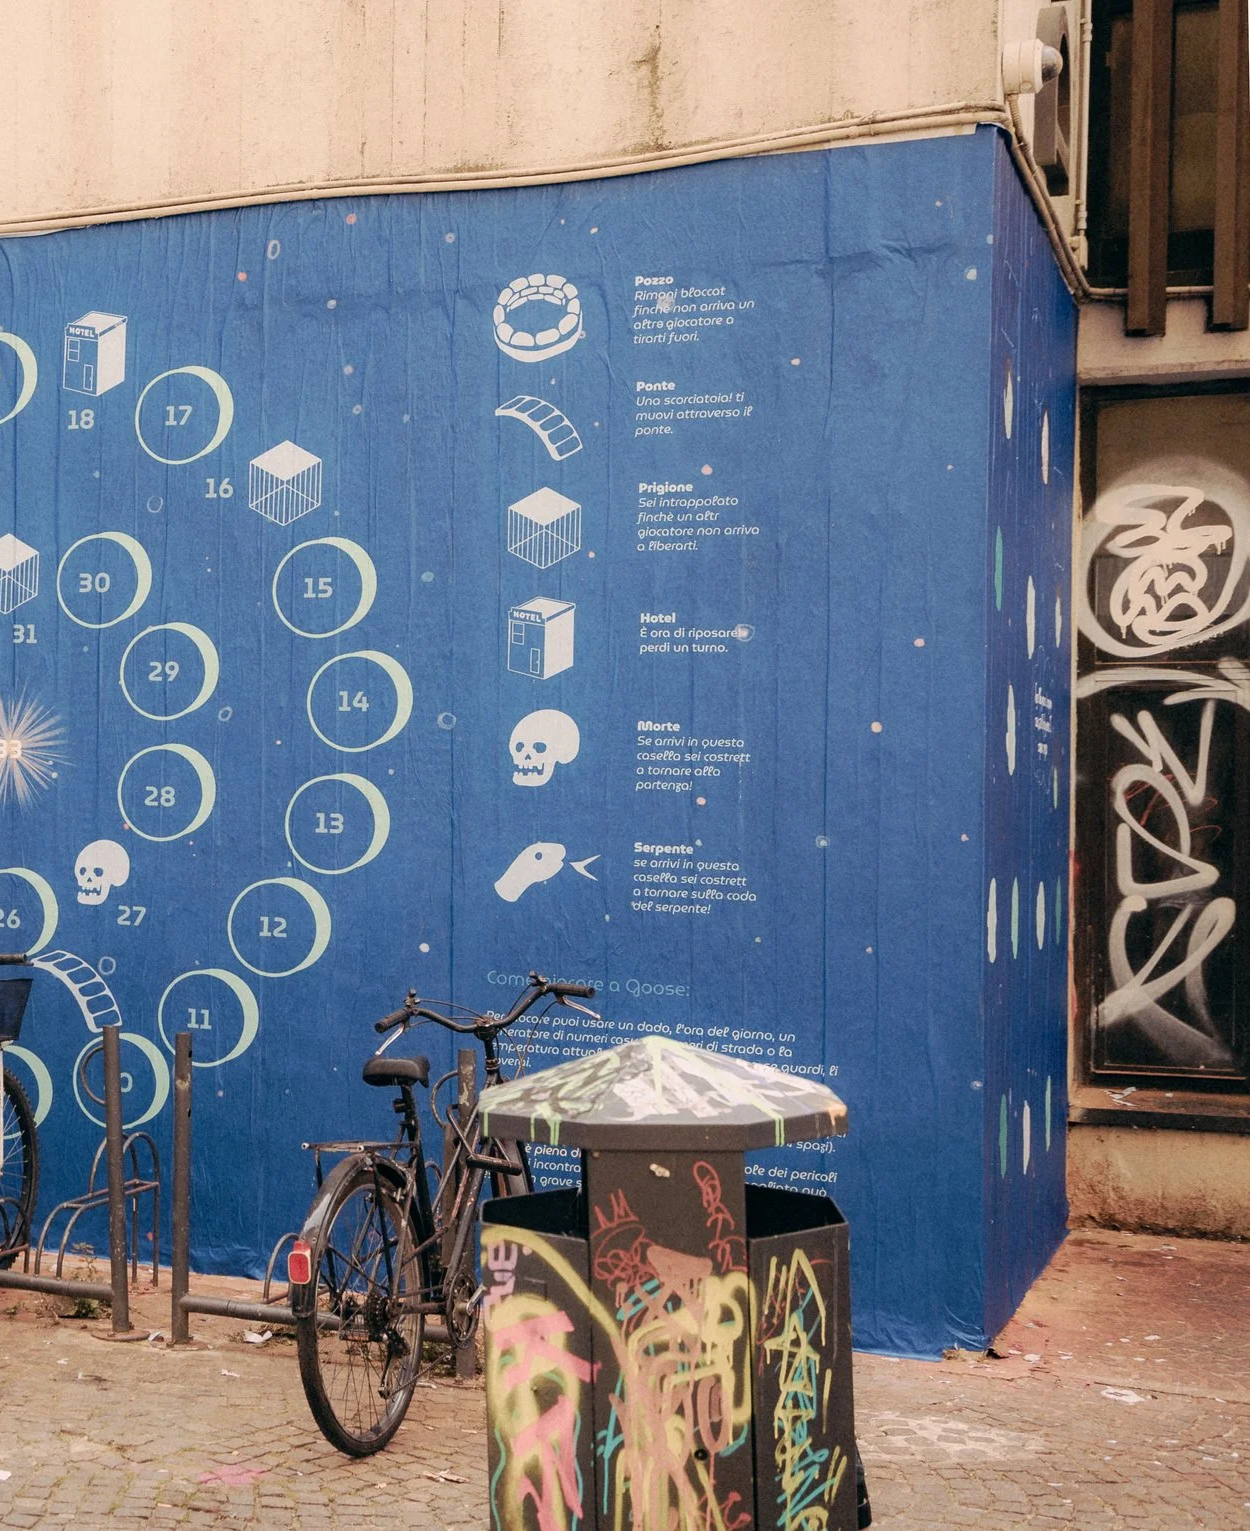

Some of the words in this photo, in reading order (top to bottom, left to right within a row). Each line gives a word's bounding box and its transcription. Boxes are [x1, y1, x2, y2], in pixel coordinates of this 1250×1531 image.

[634, 275, 674, 286] Pozzo
[634, 289, 678, 301] Rimani
[673, 303, 696, 313] non
[700, 300, 735, 311] arriva
[739, 300, 755, 309] un
[666, 316, 723, 330] giocatore
[726, 316, 734, 325] a
[70, 326, 95, 338] HOTEL
[633, 333, 666, 344] tirarti
[667, 331, 700, 345] fuori.
[636, 381, 676, 392] Ponte
[636, 396, 661, 406] Una
[664, 392, 733, 405] scorciatoia!
[735, 392, 745, 402] ti
[67, 409, 95, 431] 18
[165, 405, 193, 426] 17
[635, 410, 674, 421] muovi
[676, 409, 740, 420] attraverso
[743, 405, 754, 416] il
[634, 425, 674, 437] ponte.
[205, 478, 234, 498] 16
[638, 482, 694, 495] Prigione
[638, 497, 657, 508] Sei
[659, 496, 739, 509] intrappolato
[636, 511, 674, 524] finchè
[677, 513, 692, 522] un
[637, 526, 694, 539] giocatore
[696, 527, 721, 536] non
[724, 525, 760, 535] arriva
[637, 543, 645, 551] a
[648, 541, 699, 551] liberarti.
[79, 573, 110, 593] 30
[303, 577, 333, 599] 15
[513, 610, 541, 622] HOTEL
[640, 612, 676, 623] Hotel
[13, 624, 37, 644] 31
[640, 626, 648, 638] È
[650, 630, 670, 638] ora
[673, 628, 685, 638] di
[640, 642, 670, 654] perdi
[673, 644, 689, 653] un
[692, 643, 729, 653] turno.
[148, 661, 180, 682] 29
[338, 691, 370, 712] 14
[637, 721, 681, 732] Morte
[637, 735, 651, 746] Se
[654, 736, 685, 747] arrivi
[688, 737, 698, 747] in
[701, 738, 745, 749] questa
[636, 751, 681, 761] casella
[684, 752, 701, 762] sei
[636, 767, 644, 775] a
[648, 766, 692, 776] tornare
[694, 766, 721, 777] alla
[635, 781, 693, 793] partenza!
[144, 786, 176, 807] 28
[315, 813, 344, 834] 13
[634, 842, 694, 856] Serpente
[633, 859, 648, 868] se
[650, 858, 681, 869] arrivi
[683, 859, 694, 869] in
[696, 861, 740, 872] questa
[633, 873, 678, 883] casella
[681, 874, 698, 884] sei
[633, 888, 641, 896] a
[644, 887, 688, 898] tornare
[691, 889, 724, 900] sulla
[726, 891, 757, 902] coda
[632, 901, 653, 911] del
[655, 903, 711, 914] serpente!
[117, 905, 147, 926] 27
[259, 916, 287, 938] 12
[487, 970, 532, 986] Come
[609, 981, 620, 992] a
[186, 1008, 212, 1030] 11
[553, 1017, 579, 1027] puoi
[582, 1019, 615, 1029] usare
[618, 1022, 634, 1031] un
[637, 1021, 672, 1035] dado,
[676, 1024, 703, 1036] l'ora
[707, 1026, 730, 1037] del
[732, 1029, 775, 1042] giorno,
[779, 1033, 795, 1042] un
[553, 1030, 564, 1040] di
[566, 1033, 608, 1043] numeri
[706, 1042, 718, 1052] di
[721, 1044, 763, 1055] strada
[767, 1048, 775, 1056] o
[779, 1046, 793, 1057] la
[829, 1065, 839, 1076] li
[525, 1143, 531, 1153] è
[534, 1145, 568, 1156] piena
[539, 1176, 573, 1187] grave
[768, 1167, 788, 1178] dei
[790, 1171, 838, 1183] pericoli
